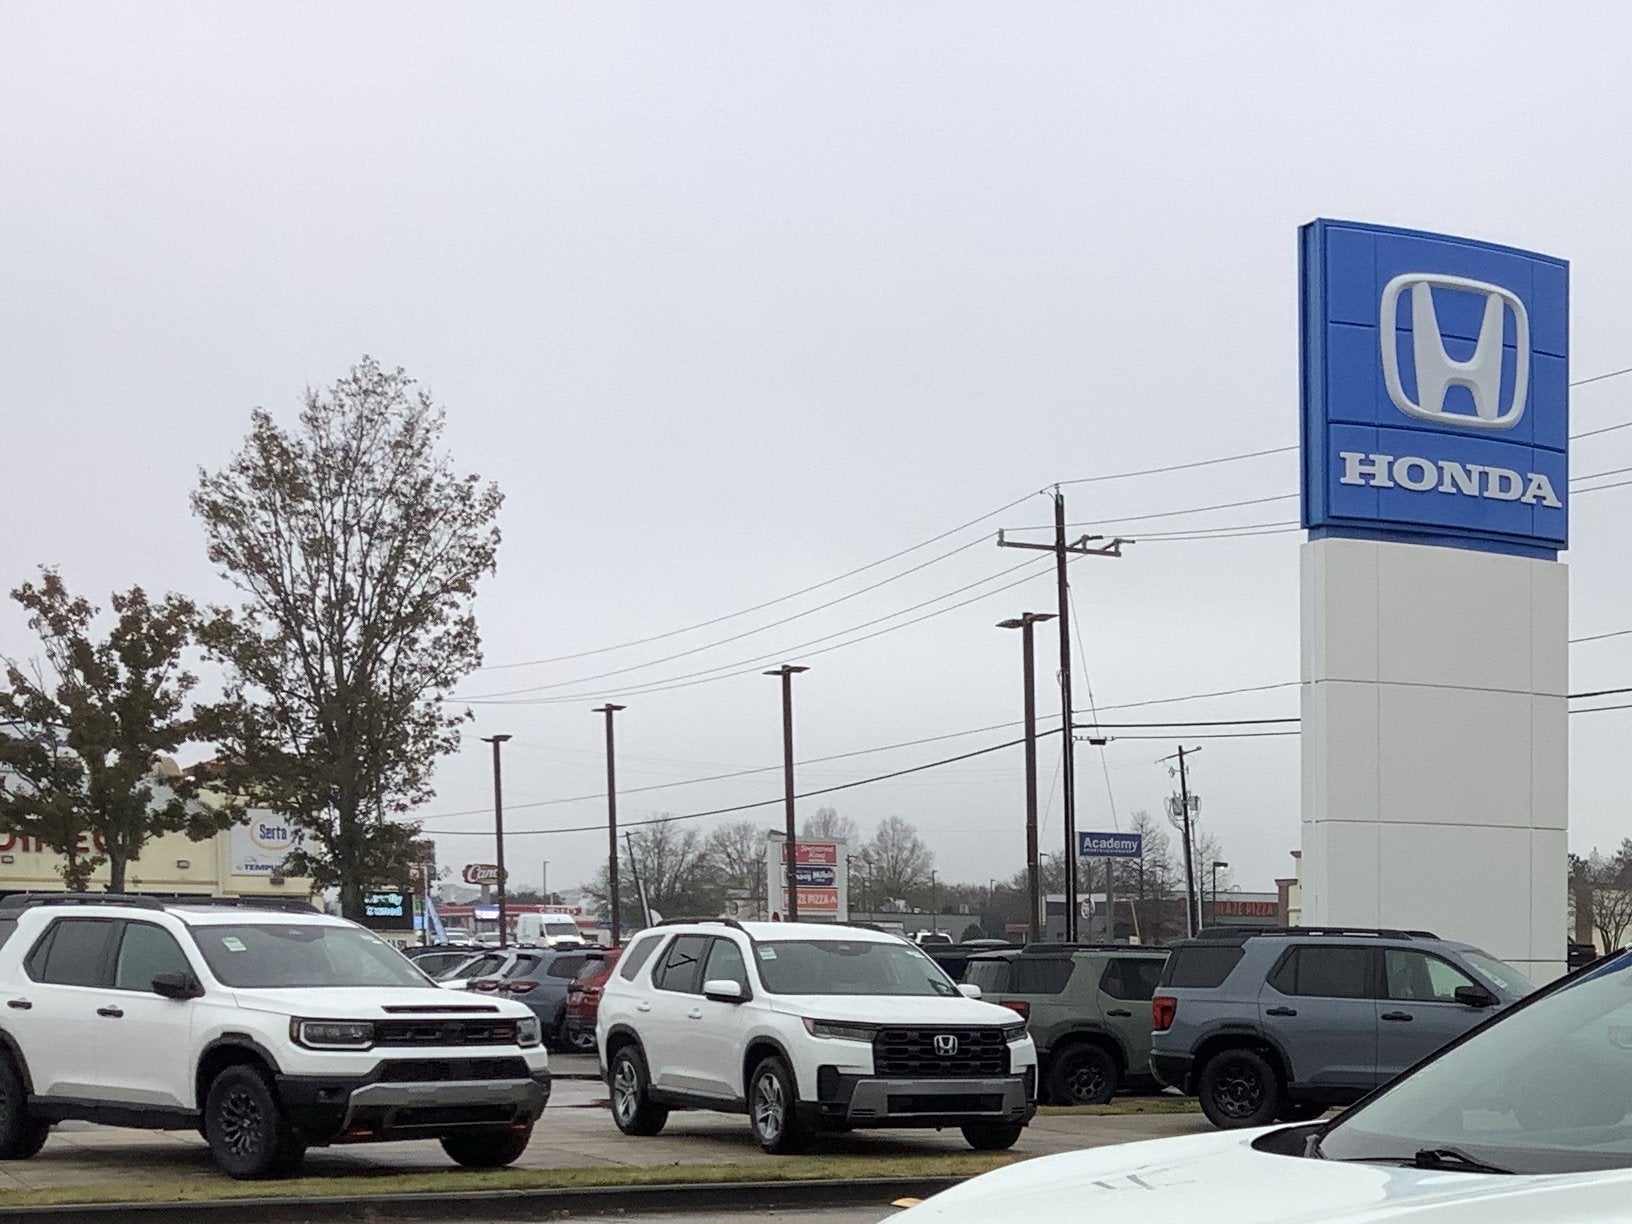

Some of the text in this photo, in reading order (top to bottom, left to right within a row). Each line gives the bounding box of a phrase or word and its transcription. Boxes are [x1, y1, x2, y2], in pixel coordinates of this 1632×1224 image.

[1340, 452, 1562, 508] HONDA
[259, 824, 287, 840] Serta
[1083, 837, 1138, 853] Academy
